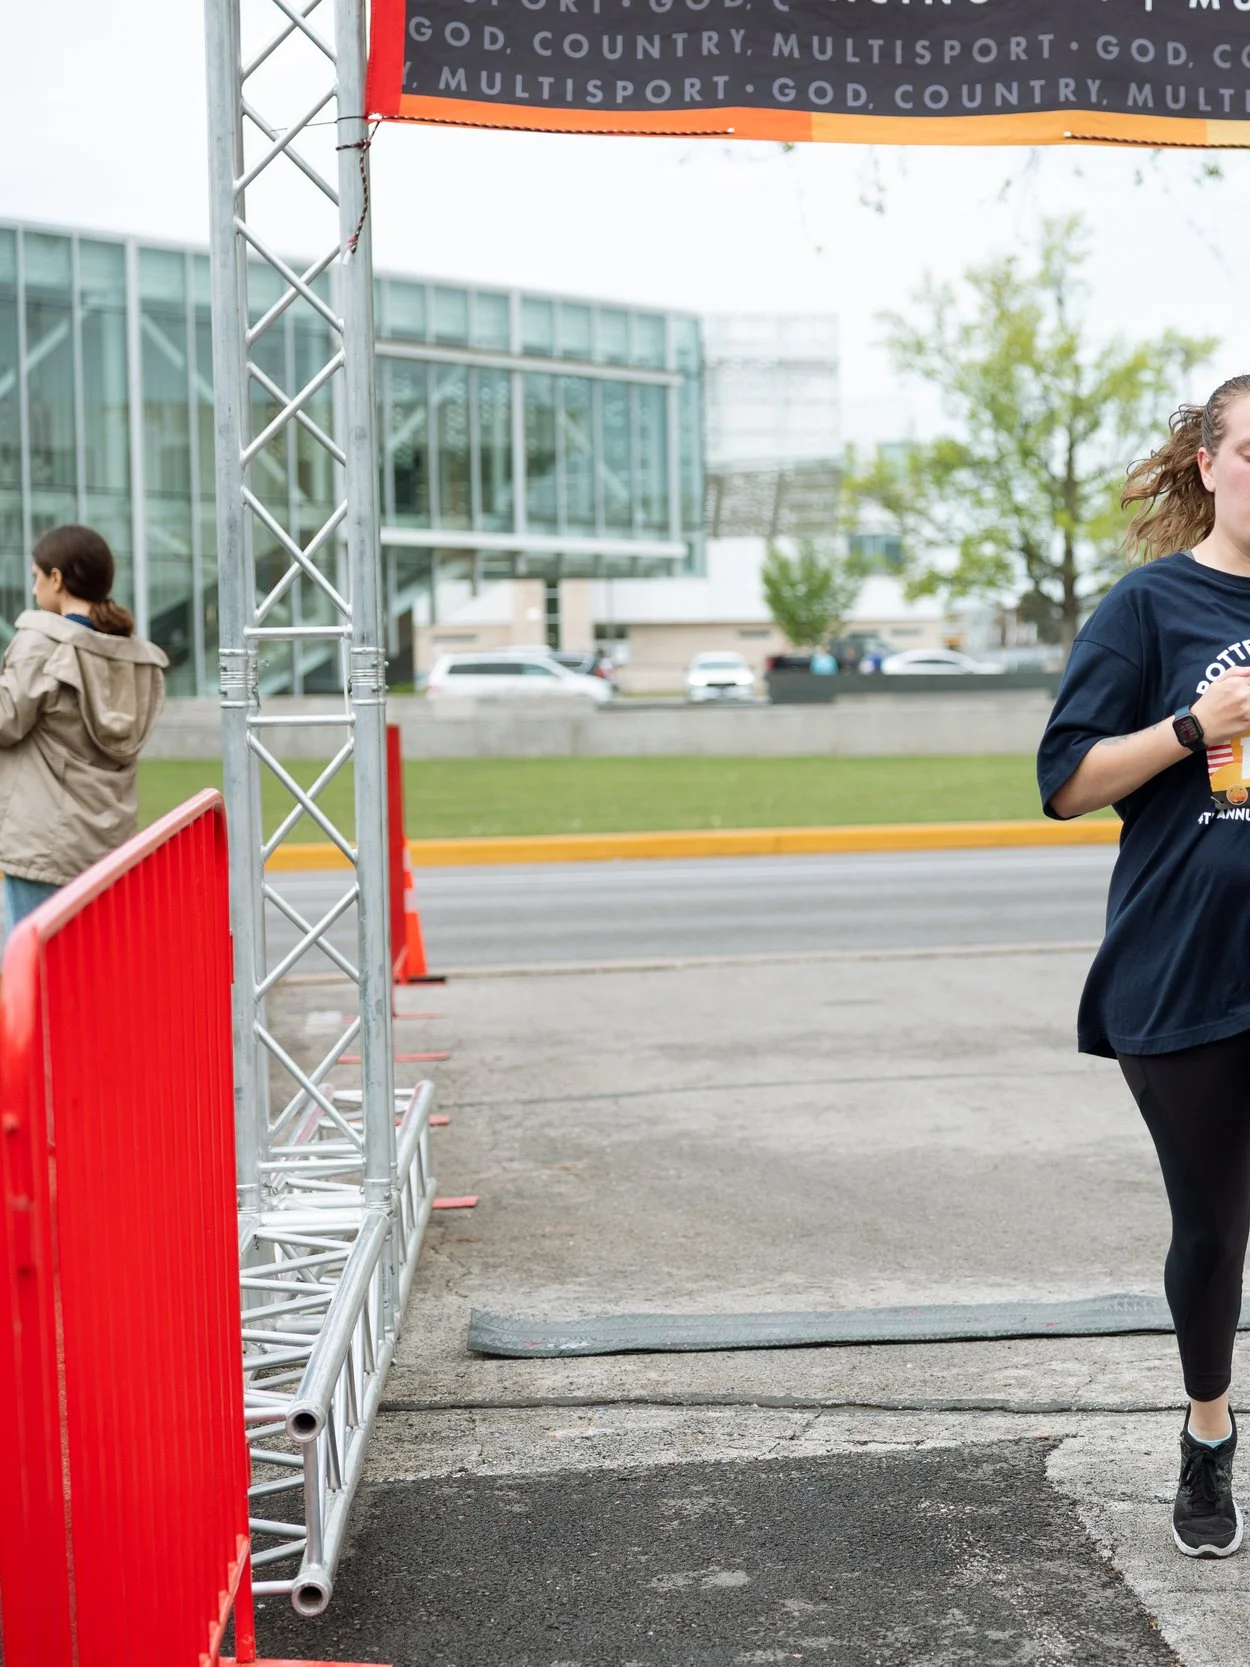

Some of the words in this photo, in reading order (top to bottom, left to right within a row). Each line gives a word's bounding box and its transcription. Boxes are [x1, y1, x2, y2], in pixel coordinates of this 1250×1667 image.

[408, 16, 512, 54] GOD,
[532, 28, 752, 59] COUNTRY,
[772, 32, 1054, 65] MULTISPORT
[1096, 34, 1194, 69] GOD,
[438, 66, 729, 104] MULTISPORT
[771, 77, 874, 110] GOD,
[894, 78, 1108, 109] COUNTRY,
